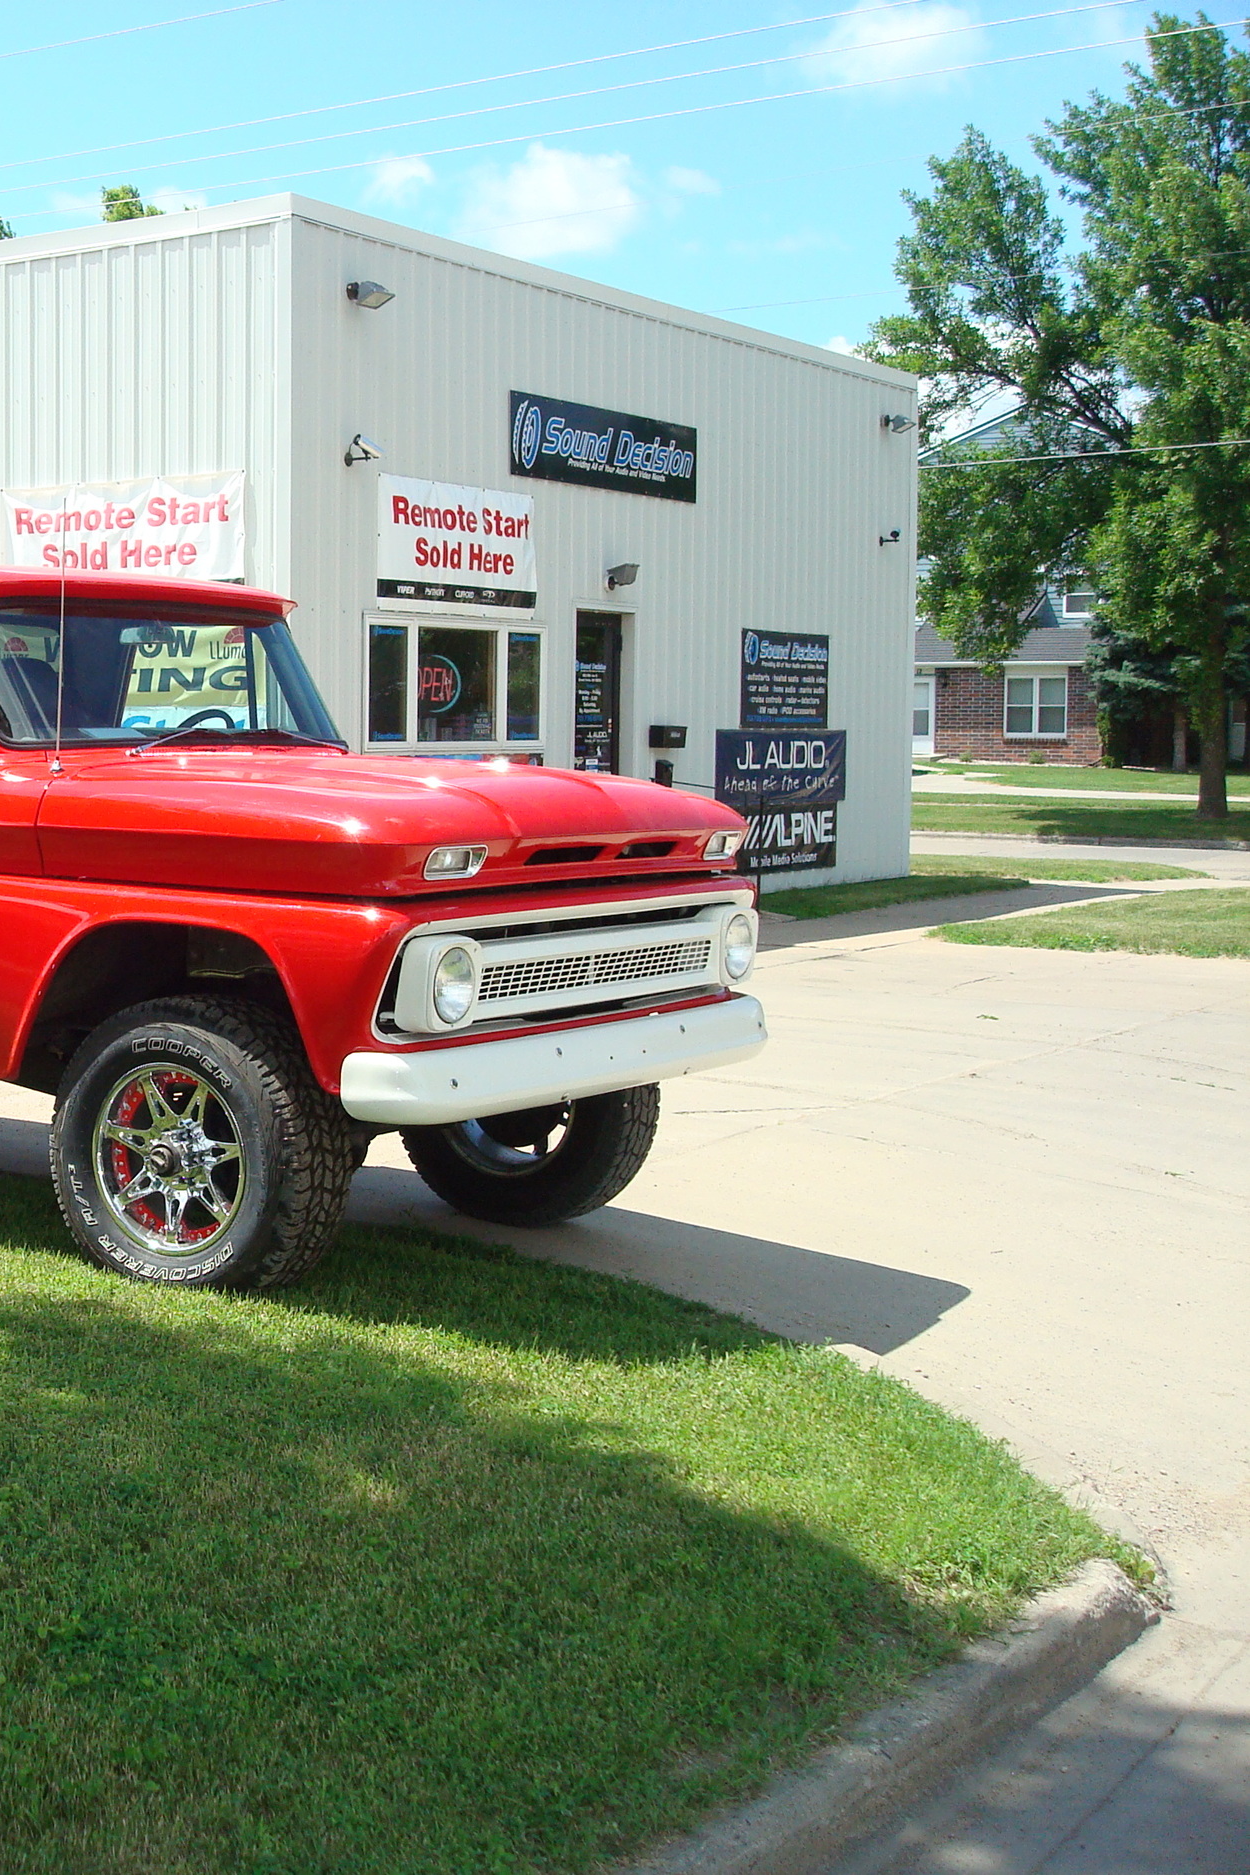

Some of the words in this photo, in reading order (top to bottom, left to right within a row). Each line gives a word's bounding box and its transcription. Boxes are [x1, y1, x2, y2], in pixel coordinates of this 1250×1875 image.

[541, 416, 614, 464] Sound
[614, 430, 694, 479] Decision
[15, 502, 135, 535] Remote
[147, 494, 229, 527] Start
[392, 495, 478, 533] Remote
[482, 507, 530, 540] Start
[42, 540, 108, 570] Sold
[121, 539, 197, 568] Here
[415, 537, 462, 570] Sold
[469, 543, 514, 575] Here
[759, 639, 791, 659] Sound
[791, 642, 827, 662] Decision
[132, 665, 248, 692] ING
[737, 741, 760, 770] JL
[764, 741, 826, 770] AUDIO
[762, 775, 777, 789] of
[781, 775, 799, 791] the
[750, 856, 771, 868] Moile
[772, 853, 791, 866] Media
[791, 852, 817, 864] Solutions
[131, 1037, 232, 1090] COOPER
[68, 1164, 99, 1226] A/T3
[98, 1235, 234, 1282] DISCOVERER
